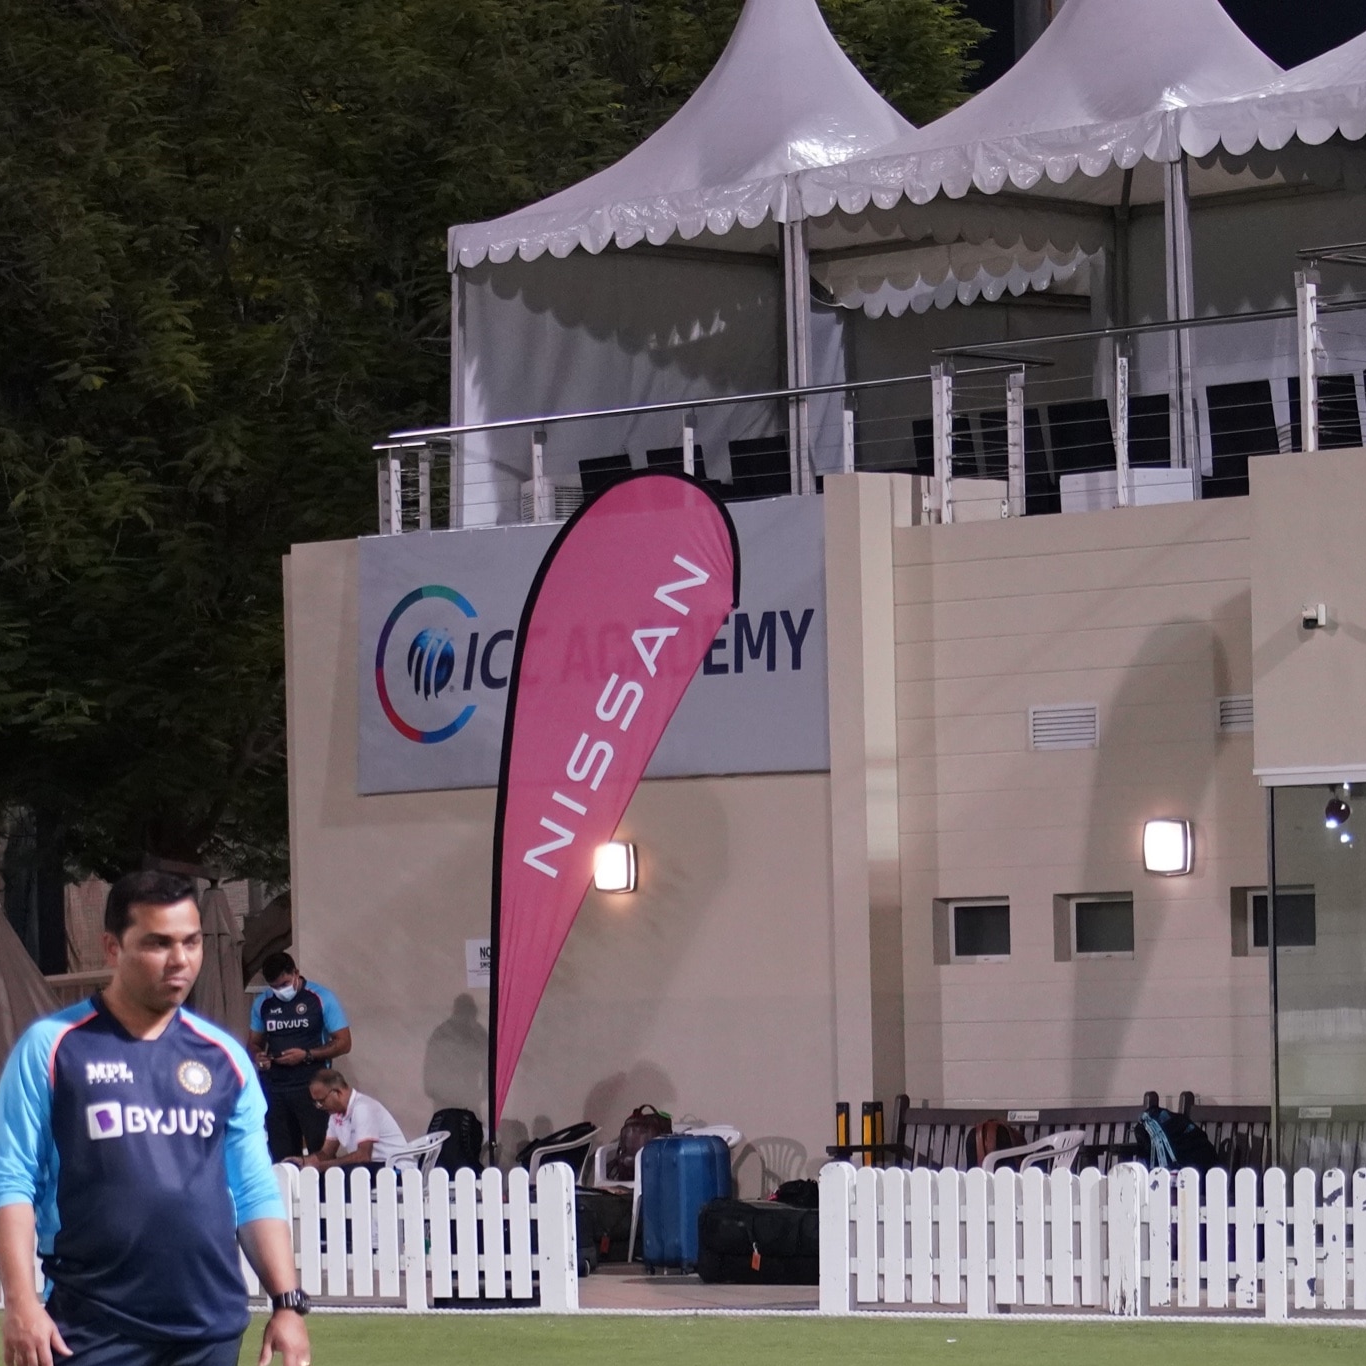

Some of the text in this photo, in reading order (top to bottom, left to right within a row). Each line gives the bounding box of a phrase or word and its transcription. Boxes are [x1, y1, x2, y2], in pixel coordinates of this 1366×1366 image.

[523, 554, 711, 879] NISSAN
[276, 1018, 310, 1030] BYJU'S
[86, 1061, 134, 1080] MPL
[124, 1105, 216, 1138] BYJU'S
